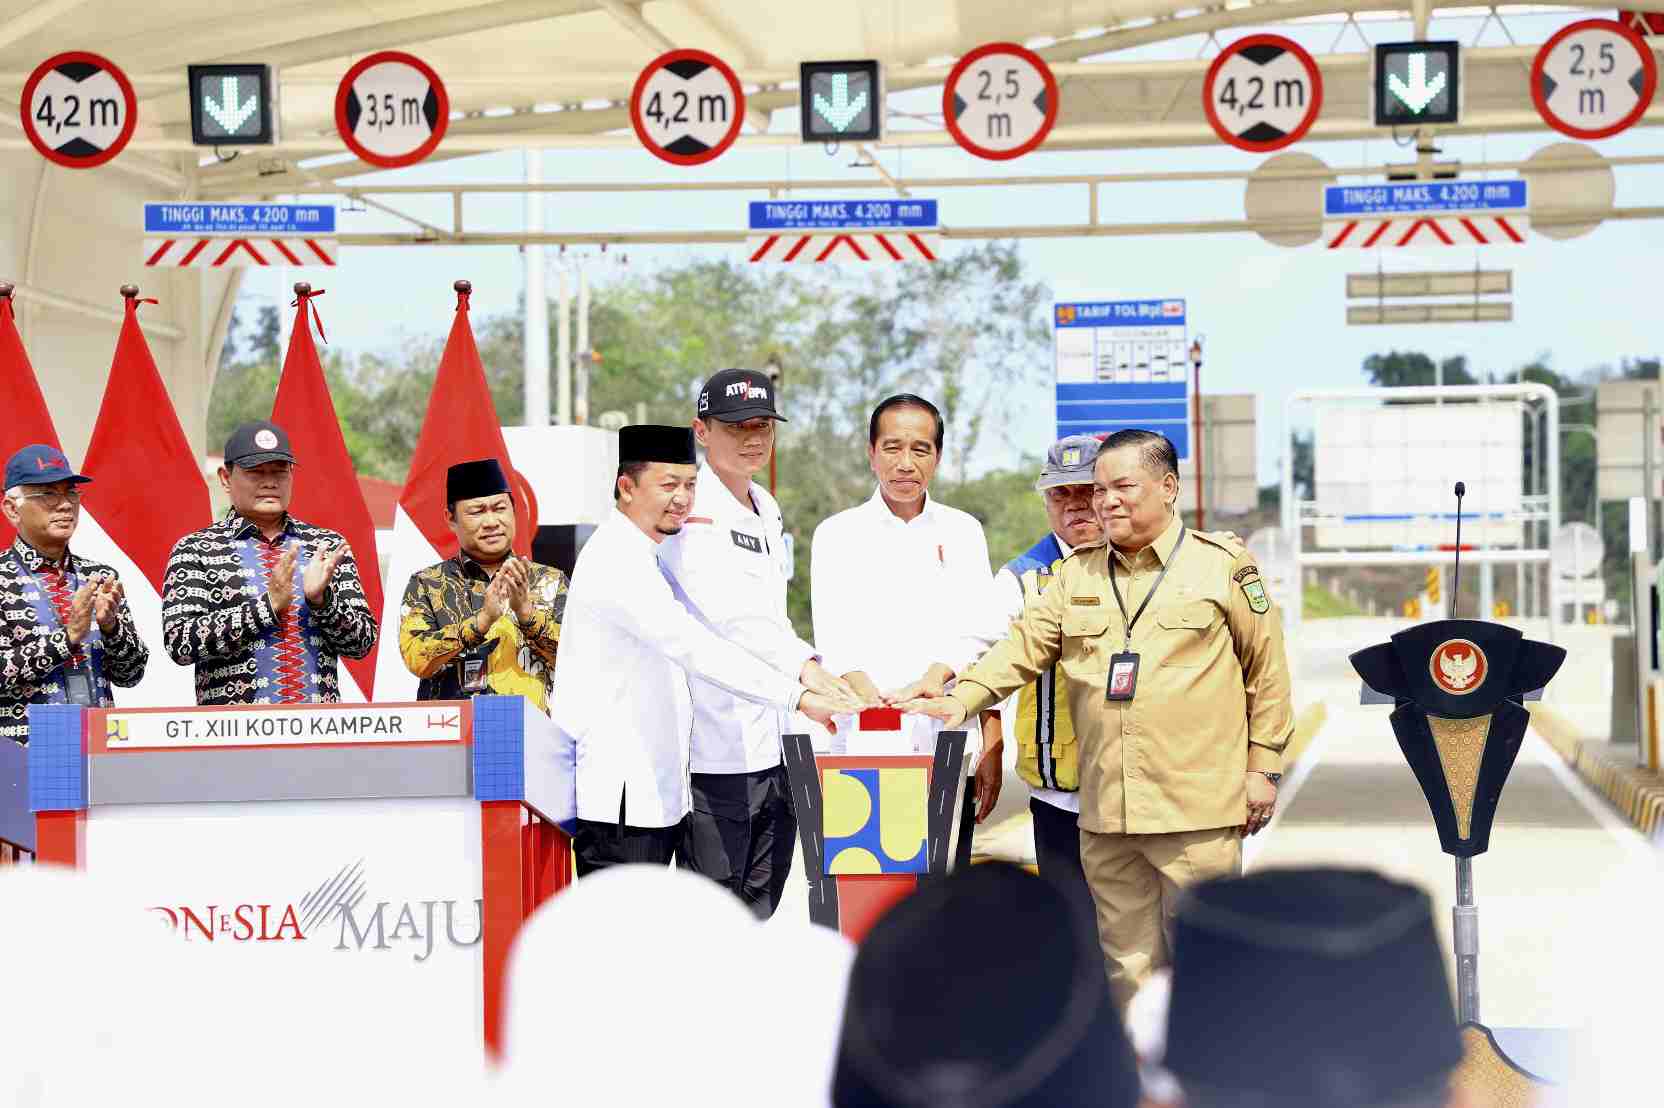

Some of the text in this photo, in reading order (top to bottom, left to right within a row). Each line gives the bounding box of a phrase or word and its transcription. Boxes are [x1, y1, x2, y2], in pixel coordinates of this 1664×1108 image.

[1569, 42, 1615, 79] 2,5
[977, 69, 1020, 105] 2,5
[1218, 77, 1304, 115] 4,2 m
[1578, 87, 1605, 115] m
[36, 96, 119, 133] 4,2 m
[366, 93, 420, 135] 3,5 m
[645, 91, 727, 129] 4,2 m
[987, 112, 1012, 139] m
[765, 203, 923, 220] TINGGI MAKS. 4.200 mm
[1343, 184, 1511, 205] TINGGI MAKS. 4.200 mm
[161, 206, 320, 223] TINGGI MAKS. 4.200 mm
[165, 719, 199, 738] GT.
[206, 718, 239, 737] XIII
[246, 717, 303, 737] KOTO
[310, 715, 403, 735] KAMPAR
[332, 898, 482, 963] MAJU
